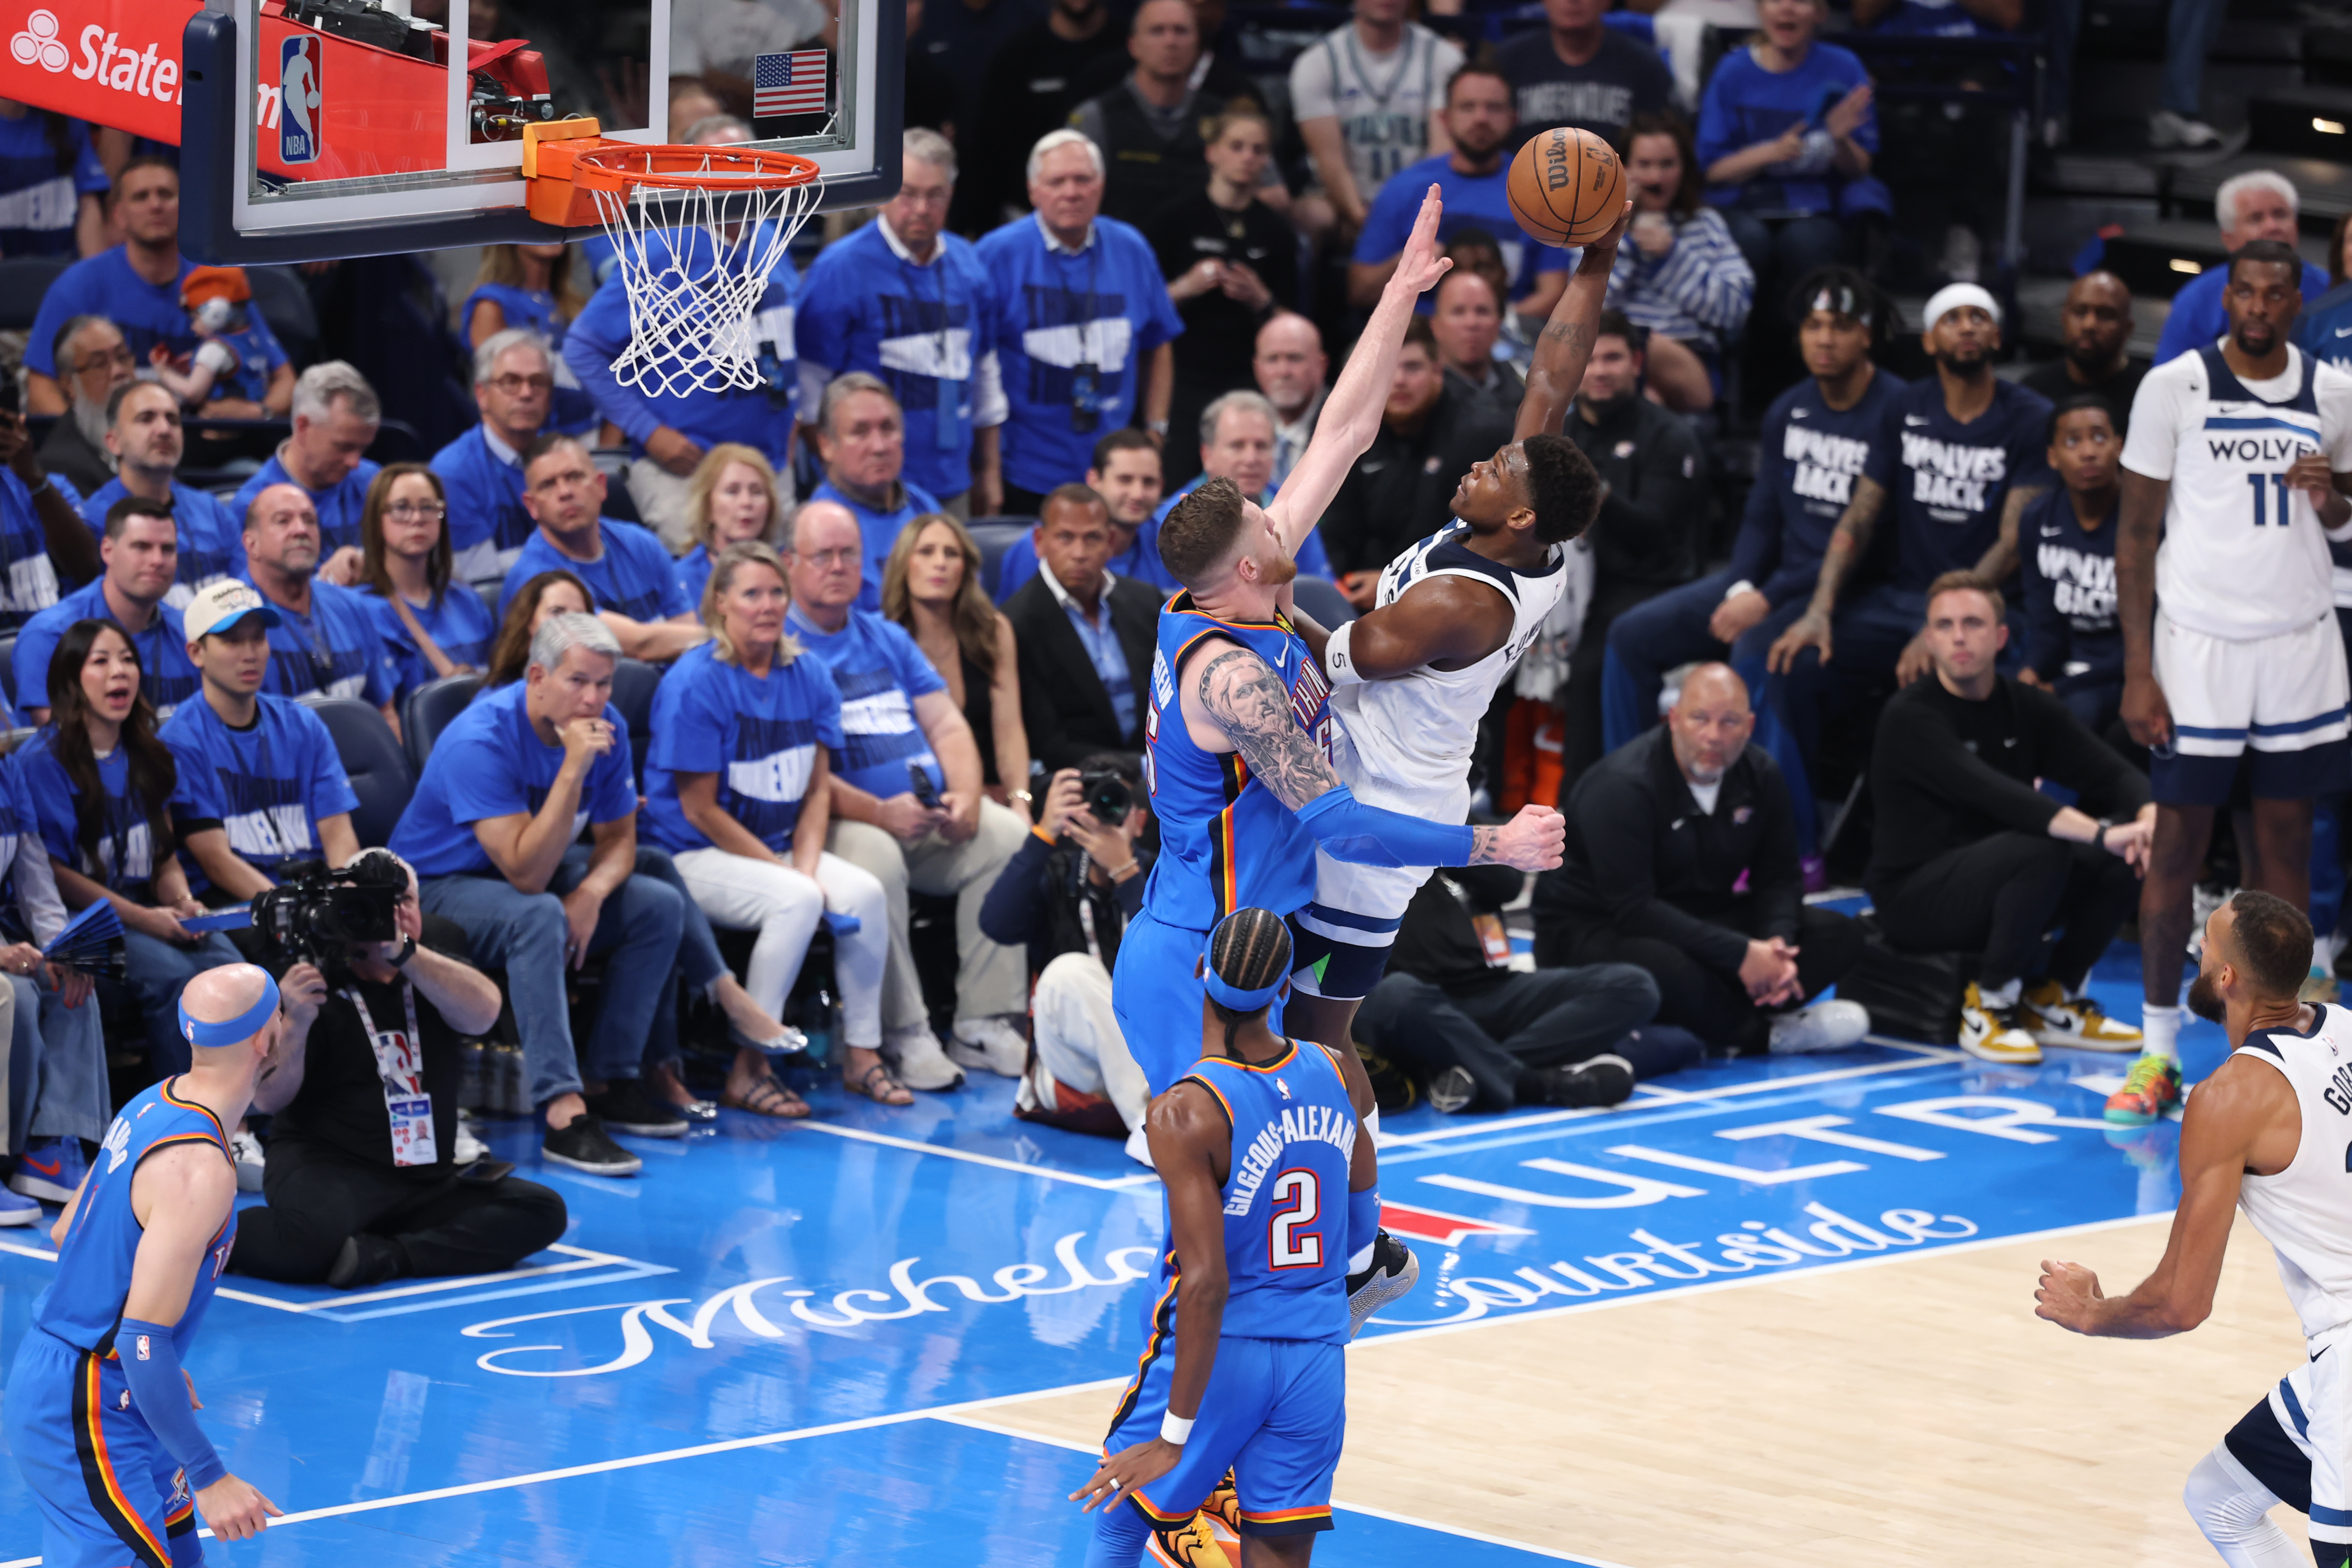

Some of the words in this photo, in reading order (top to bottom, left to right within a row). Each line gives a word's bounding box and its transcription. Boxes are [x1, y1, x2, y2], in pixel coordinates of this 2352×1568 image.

[72, 24, 178, 102] State
[286, 134, 306, 156] NBA
[1544, 128, 1570, 192] Wilson
[1900, 430, 2007, 482] WOLVES
[2208, 439, 2317, 461] WOLVE
[1913, 469, 1986, 512] BACK
[2248, 473, 2290, 526] 11
[1332, 653, 1346, 668] 5
[1291, 656, 1330, 729] THUN
[1223, 1105, 1356, 1217] GILGEOUS-ALEXAN
[1268, 1167, 1324, 1272] 2
[460, 1231, 1158, 1377] Michelo
